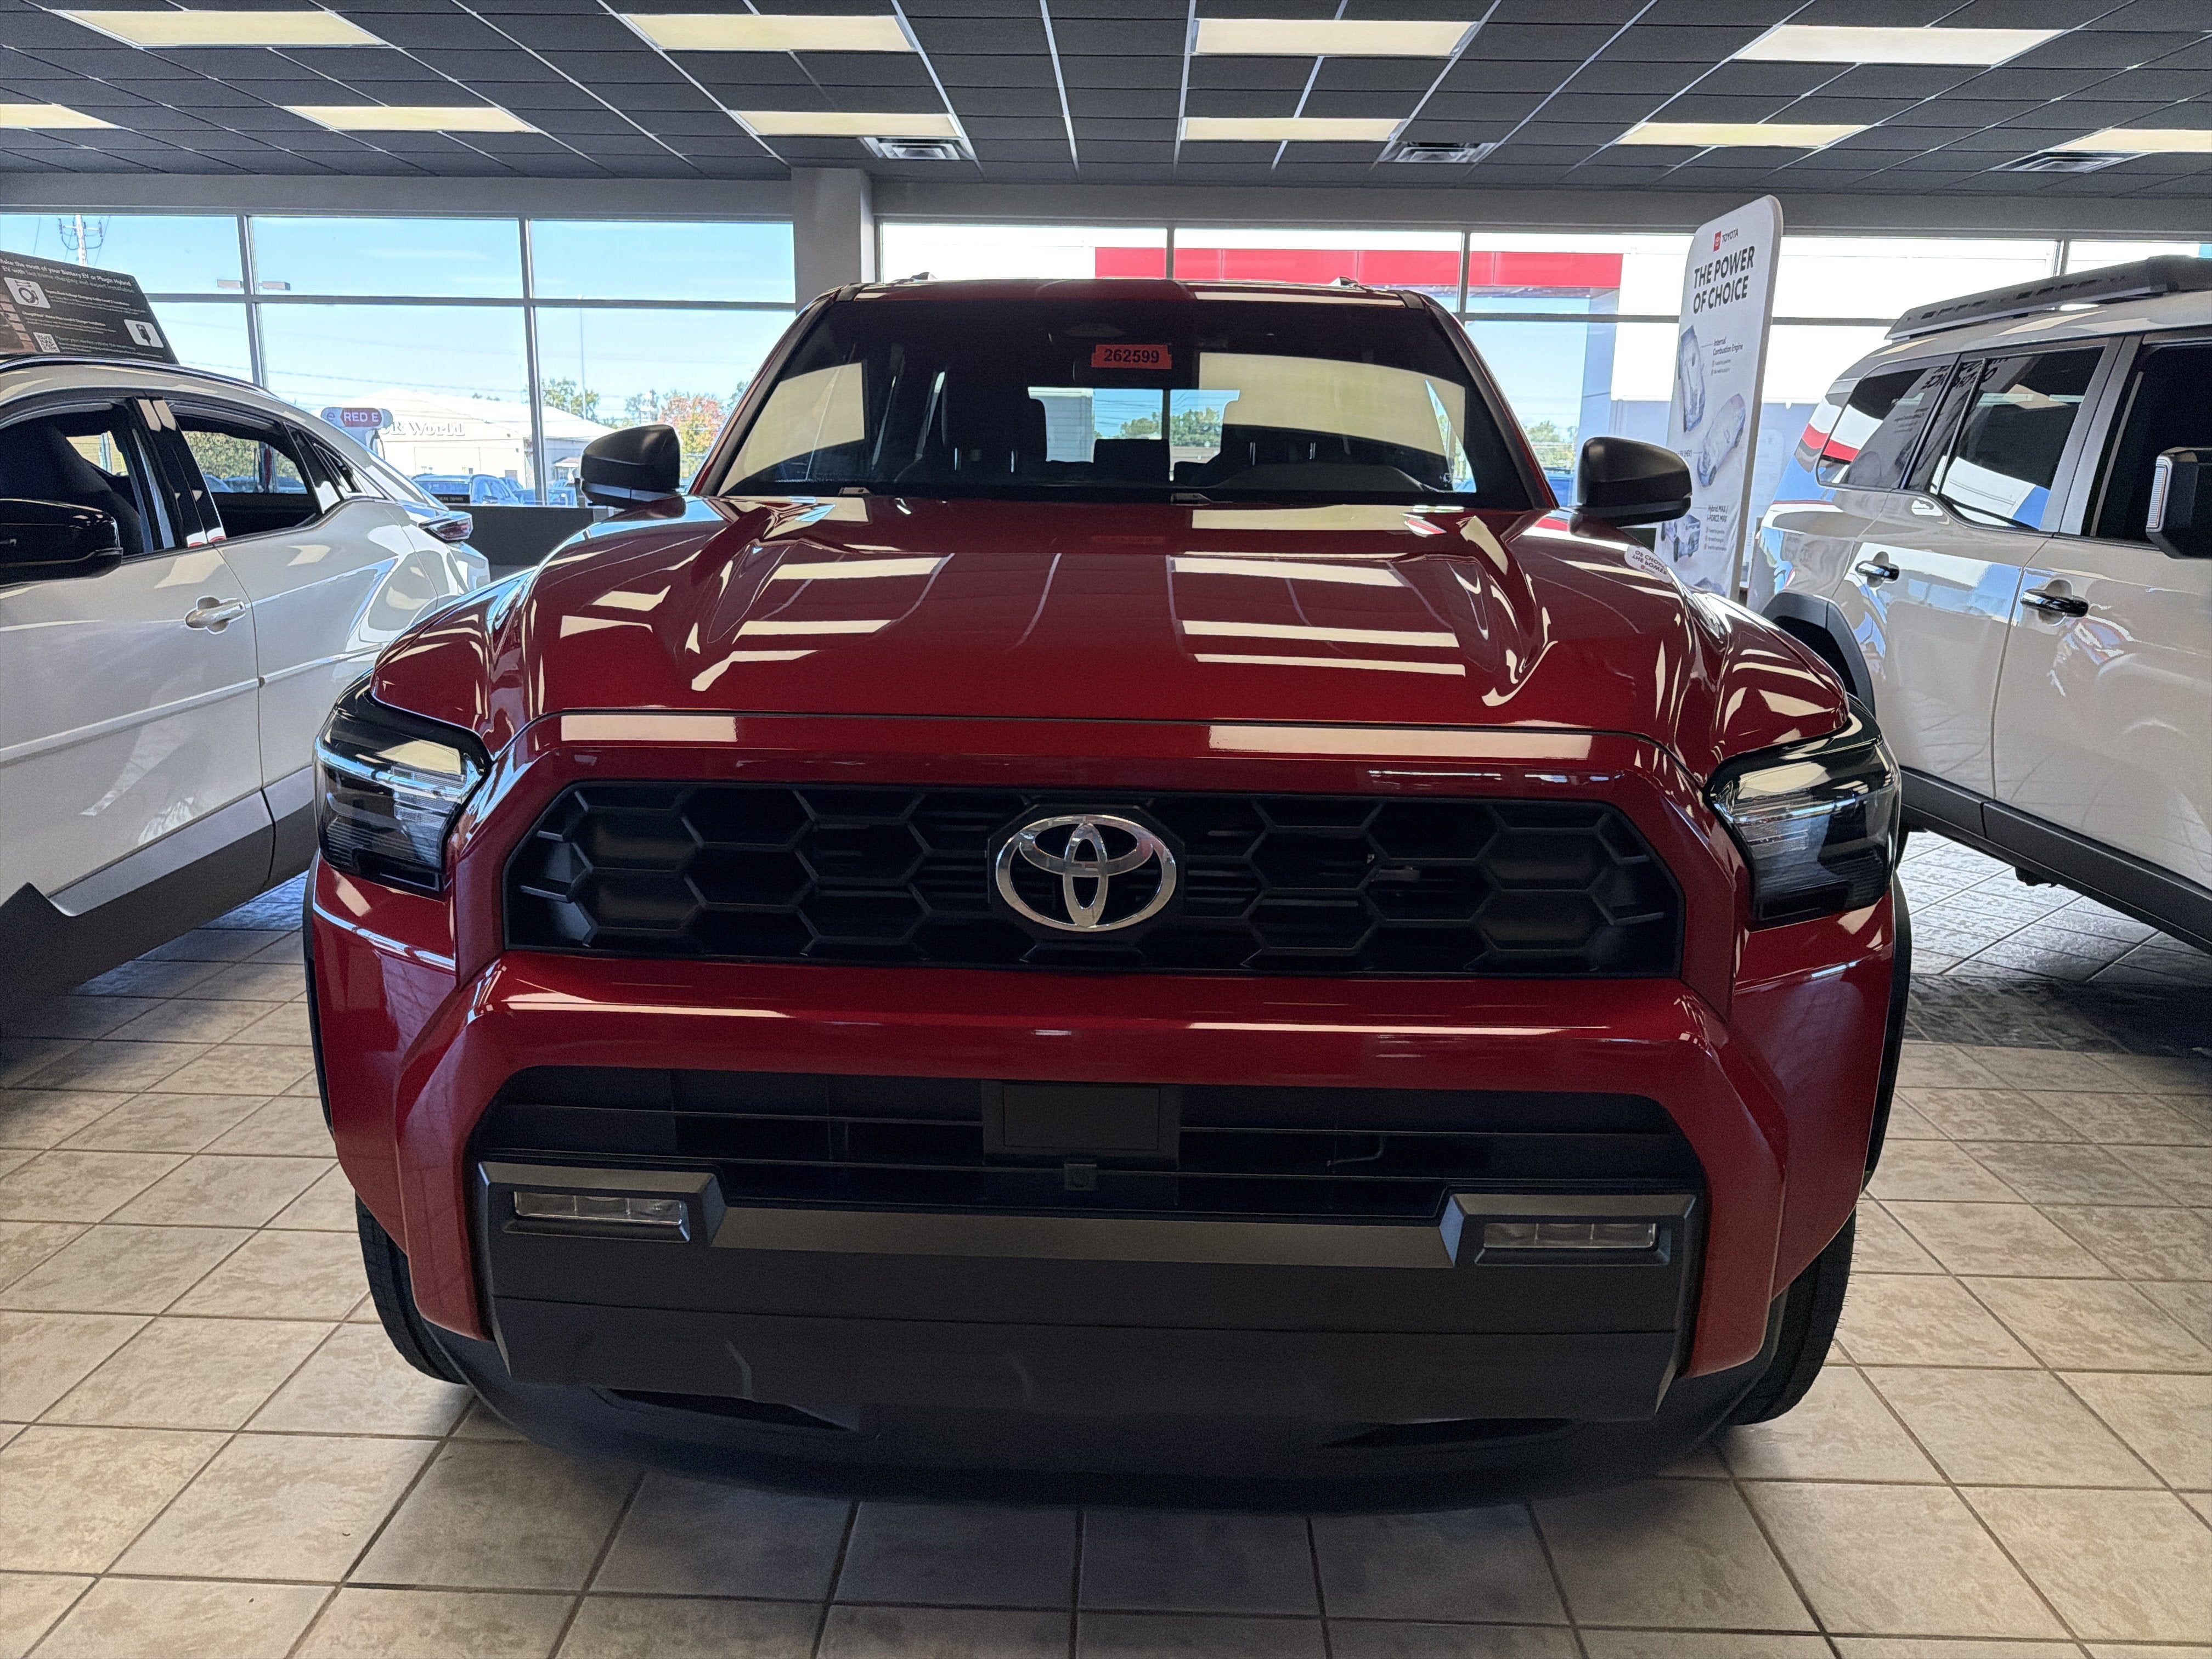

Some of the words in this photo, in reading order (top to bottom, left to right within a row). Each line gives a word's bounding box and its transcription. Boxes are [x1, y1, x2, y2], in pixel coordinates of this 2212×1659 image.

[1722, 228, 1739, 242] TOYOTA
[60, 269, 81, 279] Battery
[1694, 262, 1713, 289] THE
[1714, 246, 1755, 281] POWER
[1693, 290, 1707, 314] OF
[1708, 275, 1750, 309] CHOICE
[1104, 348, 1160, 364] 262599
[343, 411, 368, 422] RED
[371, 412, 379, 422] E
[409, 422, 466, 437] World
